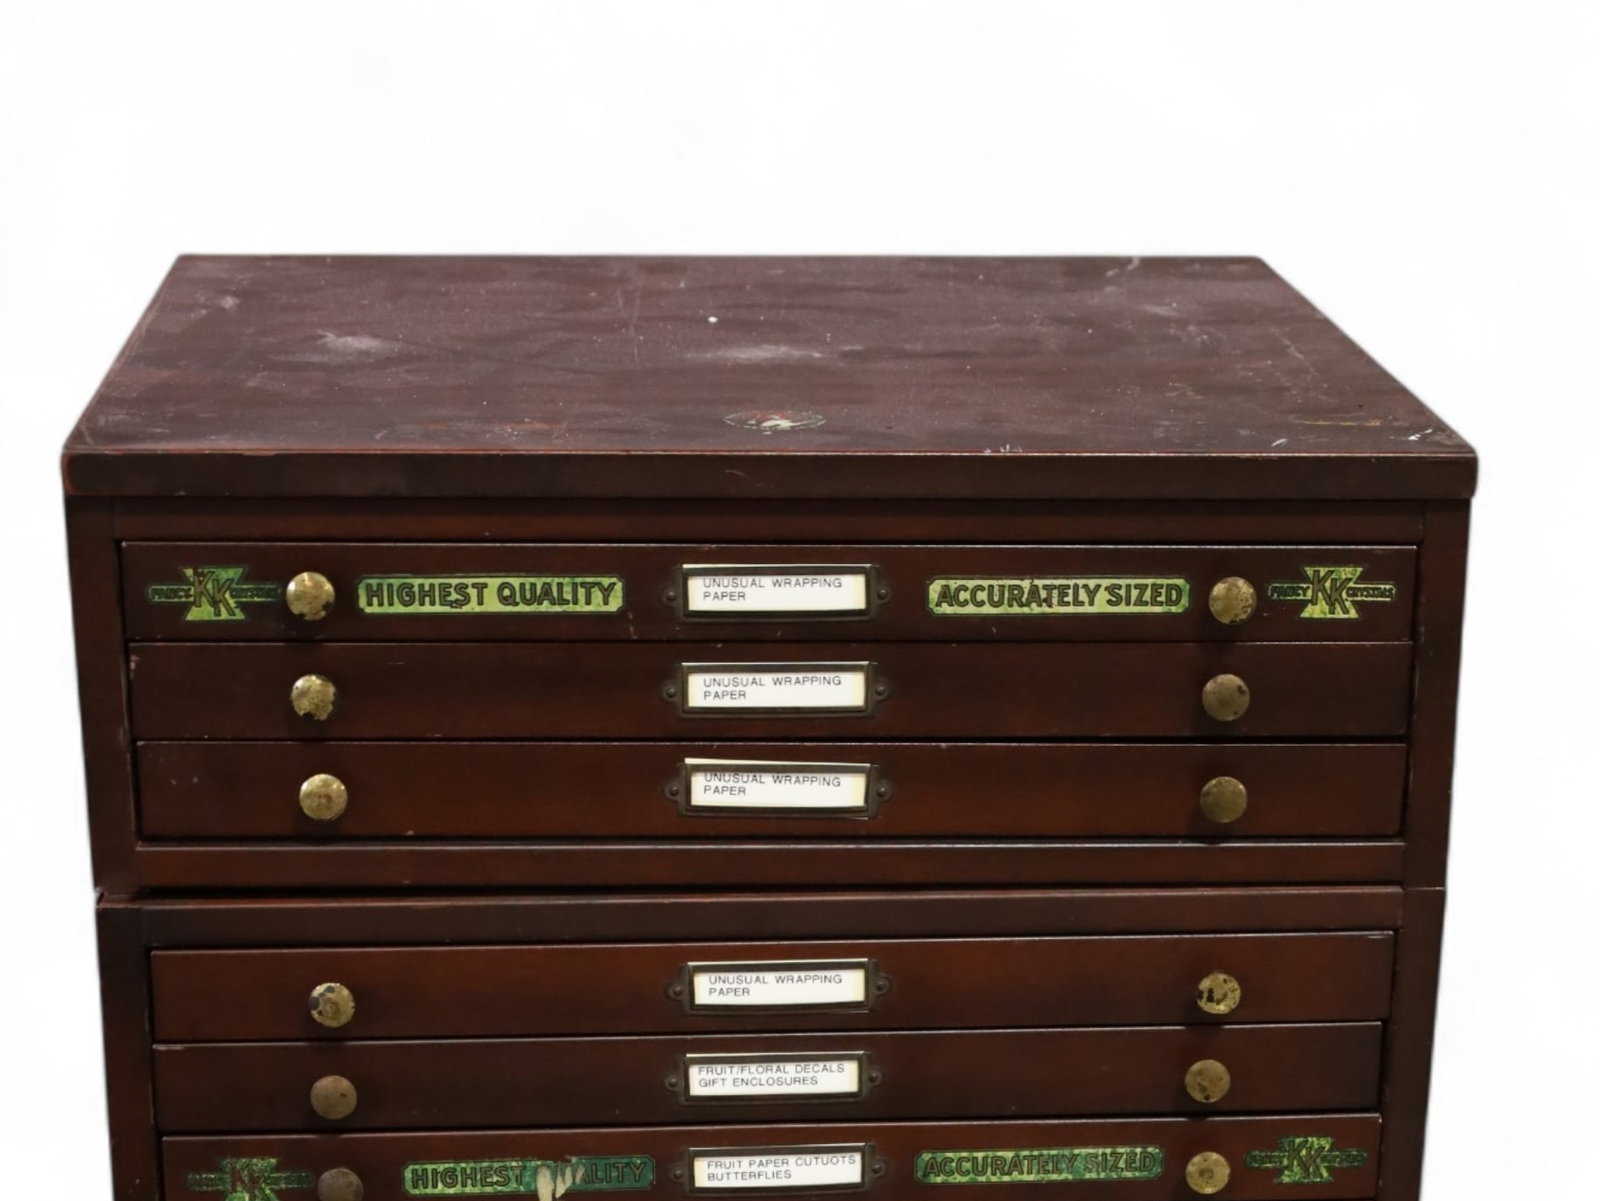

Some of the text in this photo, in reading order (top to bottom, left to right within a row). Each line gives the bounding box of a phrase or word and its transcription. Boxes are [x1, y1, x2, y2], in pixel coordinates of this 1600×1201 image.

[703, 578, 842, 588] UNUSUAL WRAPPING
[365, 582, 616, 607] HIGHEST QUALITY
[703, 592, 746, 601] PAPER
[935, 583, 1183, 608] ACCURATELY SIZED
[704, 676, 841, 687] UNUSUAL WRAPPING
[704, 691, 746, 700] PAPER
[705, 773, 841, 786] UNUSUAL WRAPPING
[704, 786, 746, 795] PAPER
[709, 974, 842, 985] UNUSUAL WRAPPING
[709, 988, 750, 997] PAPER
[698, 1064, 845, 1075] FRUIT/FLORAL DECALS
[699, 1076, 818, 1087] GIFT ENCLOSURES
[707, 1157, 856, 1170] FRUIT PAPER CUTUOTS
[923, 1151, 1155, 1178] ACCURATELY SIZED
[411, 1166, 525, 1189] HIGHEST
[707, 1172, 792, 1181] BUTTERFLIES
